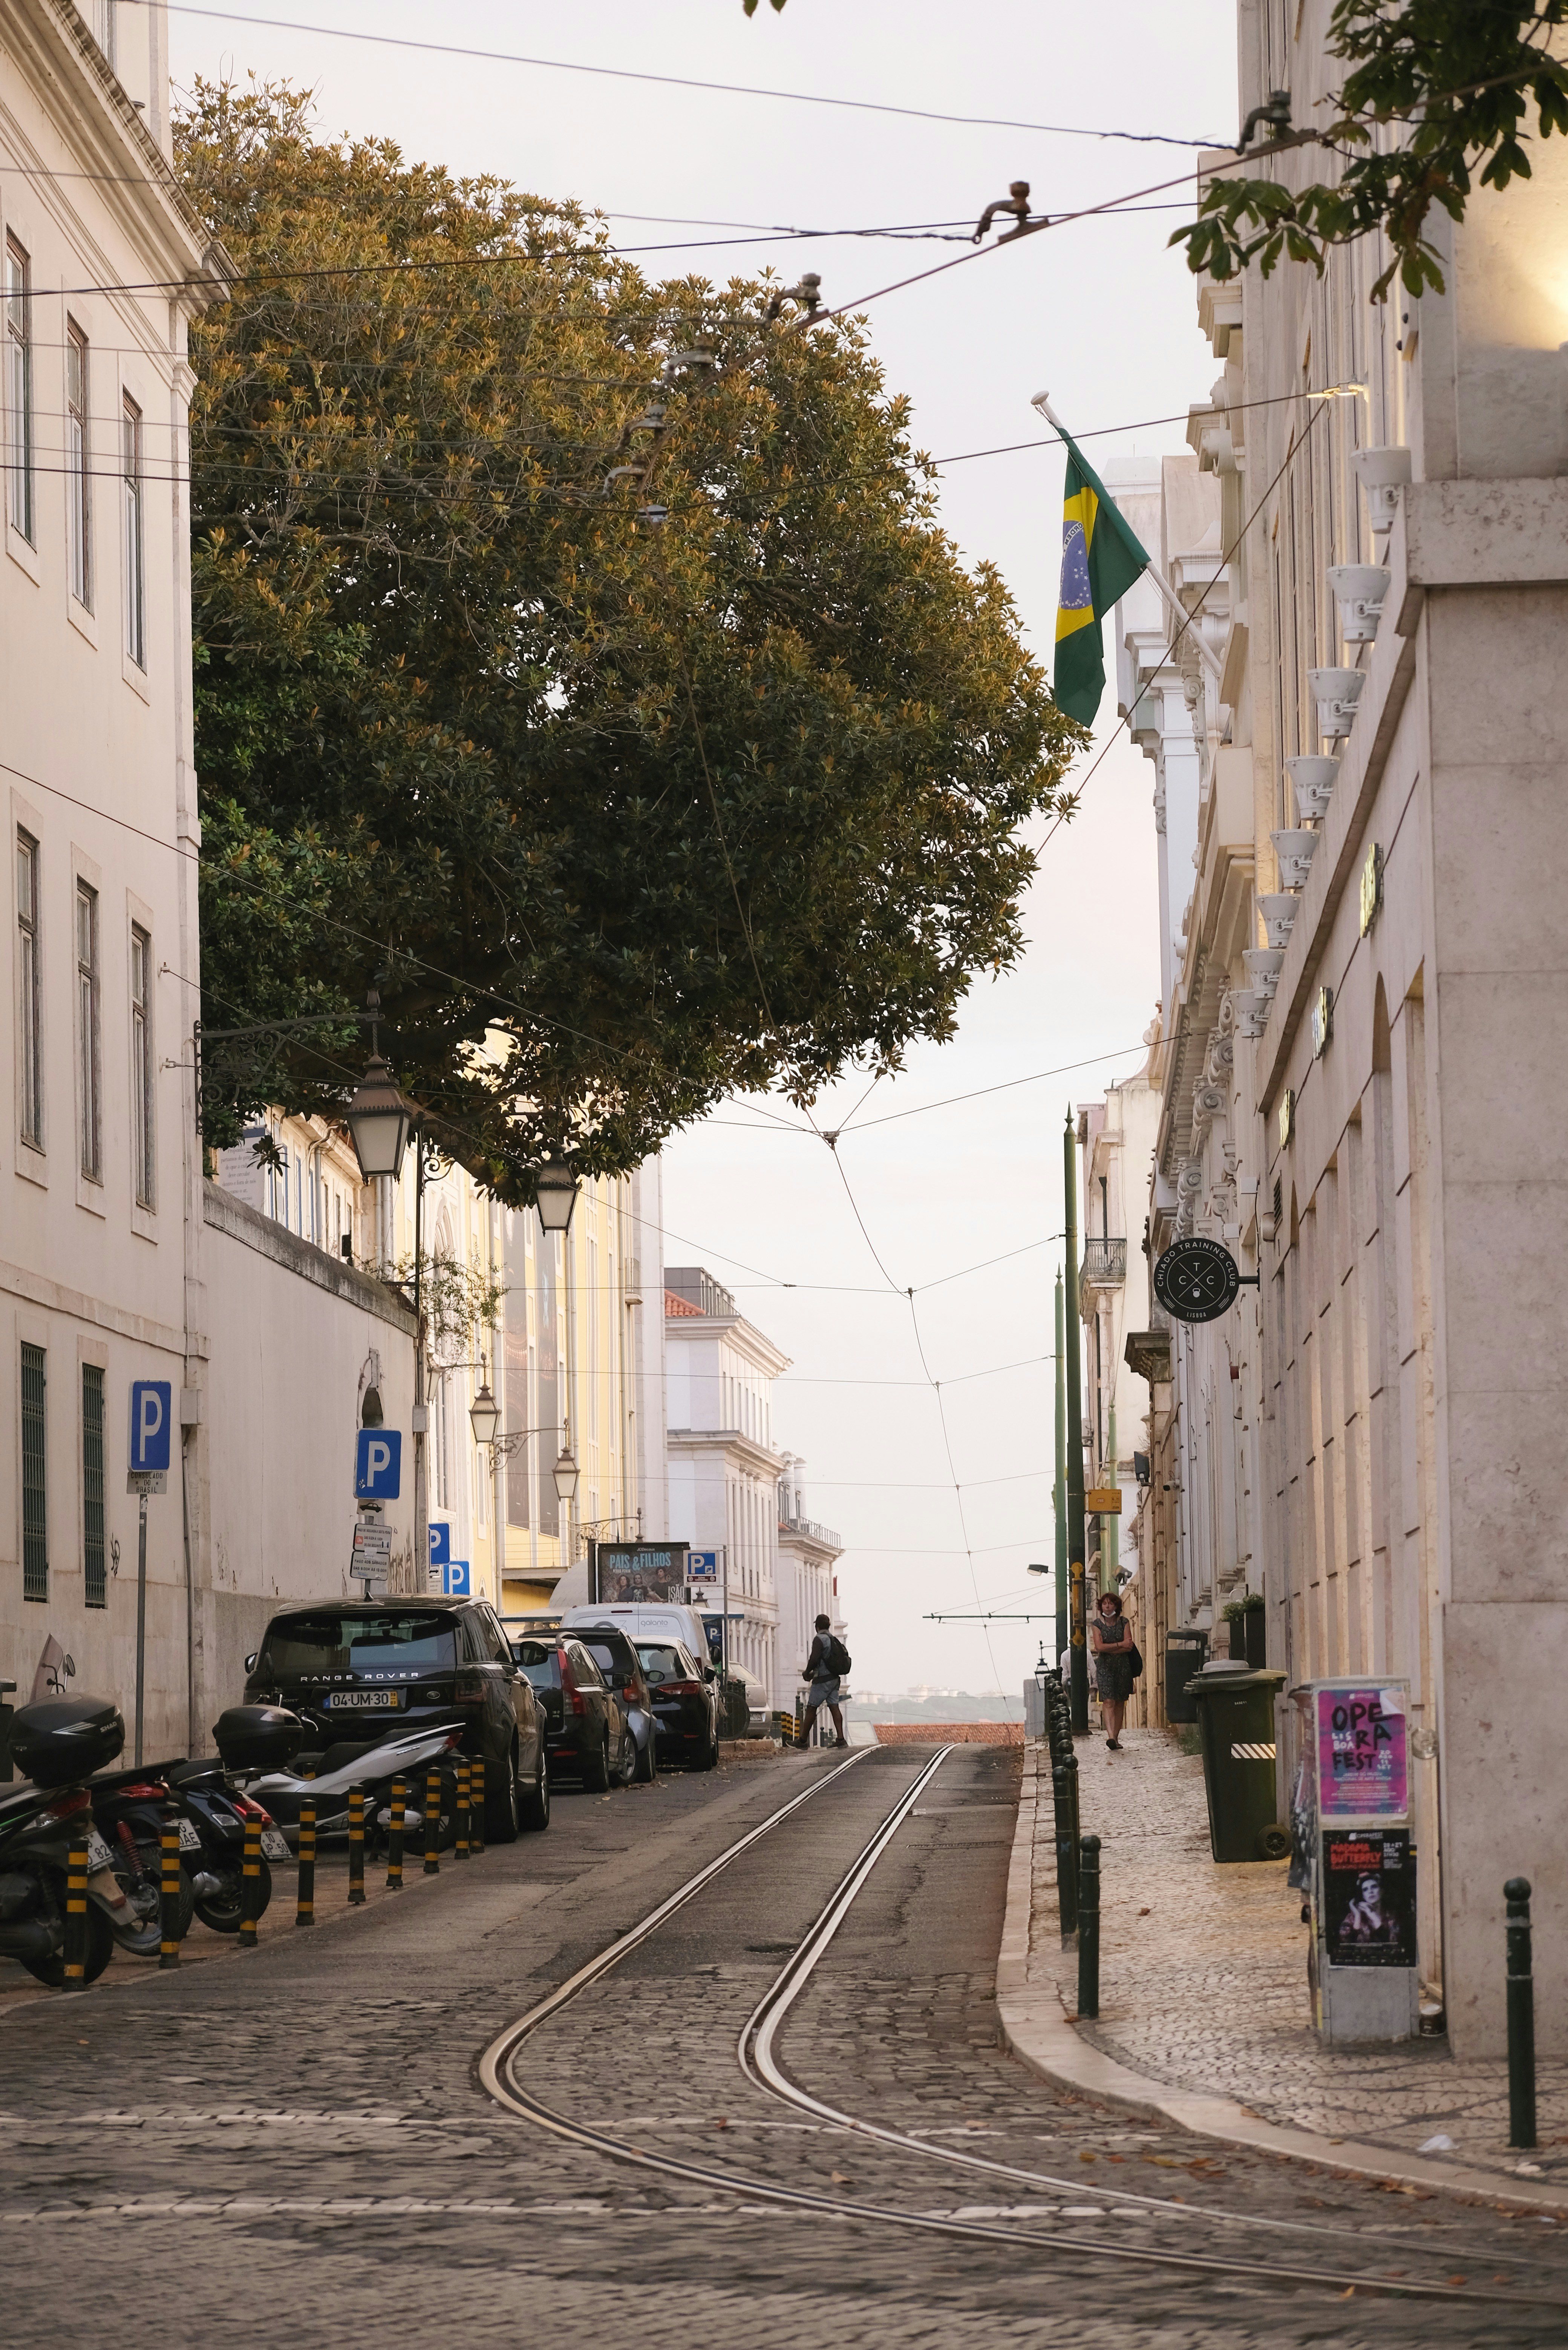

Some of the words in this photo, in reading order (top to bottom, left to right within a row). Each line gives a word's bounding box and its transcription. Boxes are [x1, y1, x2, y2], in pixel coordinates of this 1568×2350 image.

[1158, 1251, 1175, 1287] CHIADO
[1178, 1241, 1225, 1259] TRAINING
[1226, 1261, 1235, 1286] CLUB
[1193, 1263, 1200, 1271] T
[1179, 1276, 1187, 1284] C
[1207, 1276, 1214, 1284] C
[139, 1390, 162, 1461] P
[367, 1441, 390, 1487] P
[609, 1554, 630, 1569] PAIS
[632, 1556, 640, 1570] &
[640, 1552, 671, 1567] FILHOS
[691, 1555, 704, 1574] P
[449, 1564, 464, 1594] P
[671, 1584, 684, 1599] SÃO
[710, 1628, 718, 1639] P
[100, 1721, 117, 1733] SHAD
[1332, 1731, 1352, 1740] LIS
[1356, 1723, 1392, 1751] RA
[1333, 1740, 1355, 1750] BOA
[1332, 1752, 1377, 1771] FEST
[265, 1833, 275, 1843] 10
